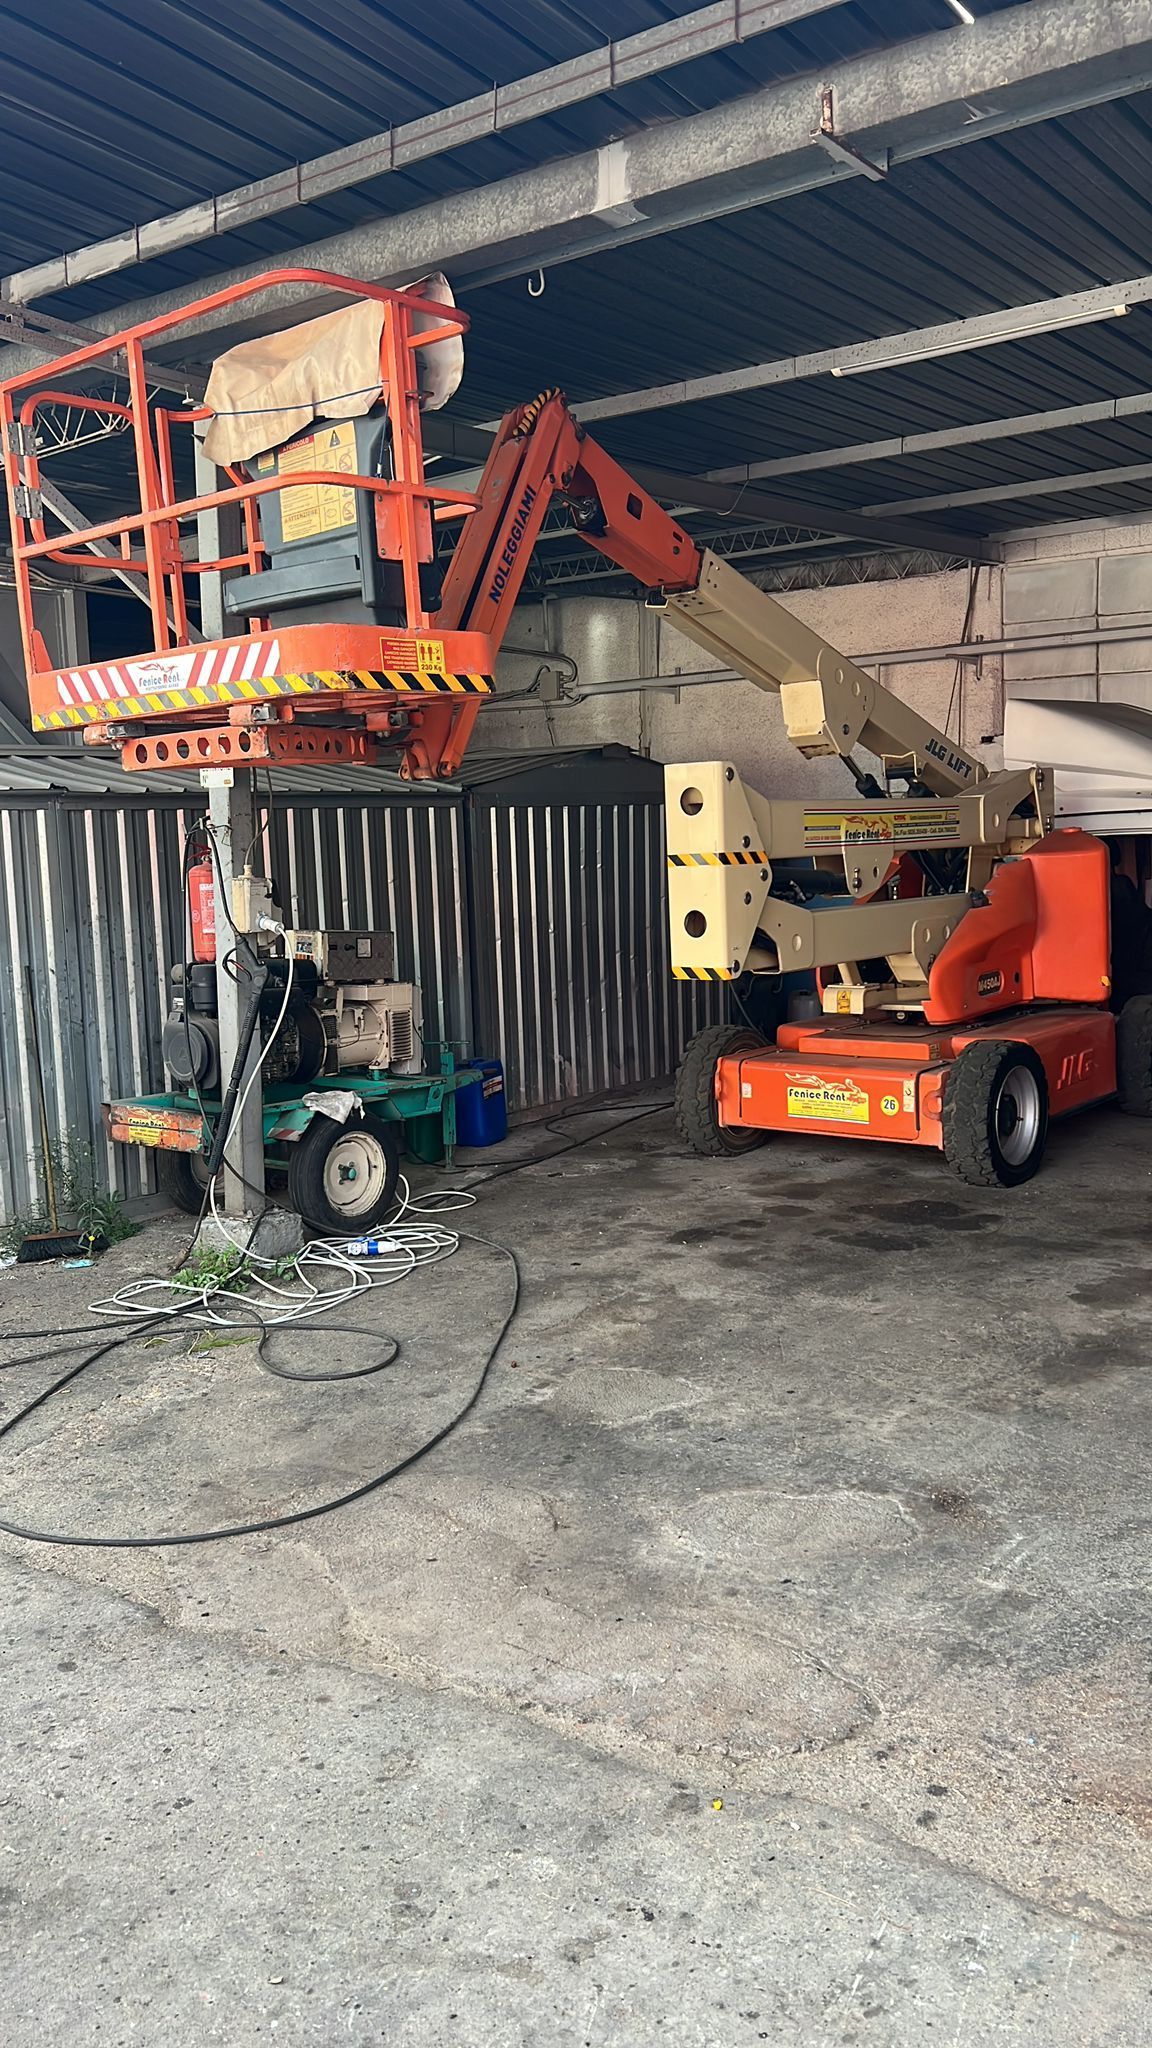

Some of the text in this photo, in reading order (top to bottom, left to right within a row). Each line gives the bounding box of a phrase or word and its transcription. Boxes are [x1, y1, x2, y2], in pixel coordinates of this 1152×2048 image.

[488, 483, 537, 605] NOLEGGIAMI
[433, 664, 443, 672] Kg
[138, 671, 180, 688] Fenice Rent
[925, 738, 972, 778] JLG LIFT
[845, 829, 866, 840] Fenice
[866, 828, 880, 839] Rent
[789, 1088, 846, 1101] Fenice Rent
[883, 1098, 896, 1110] 26
